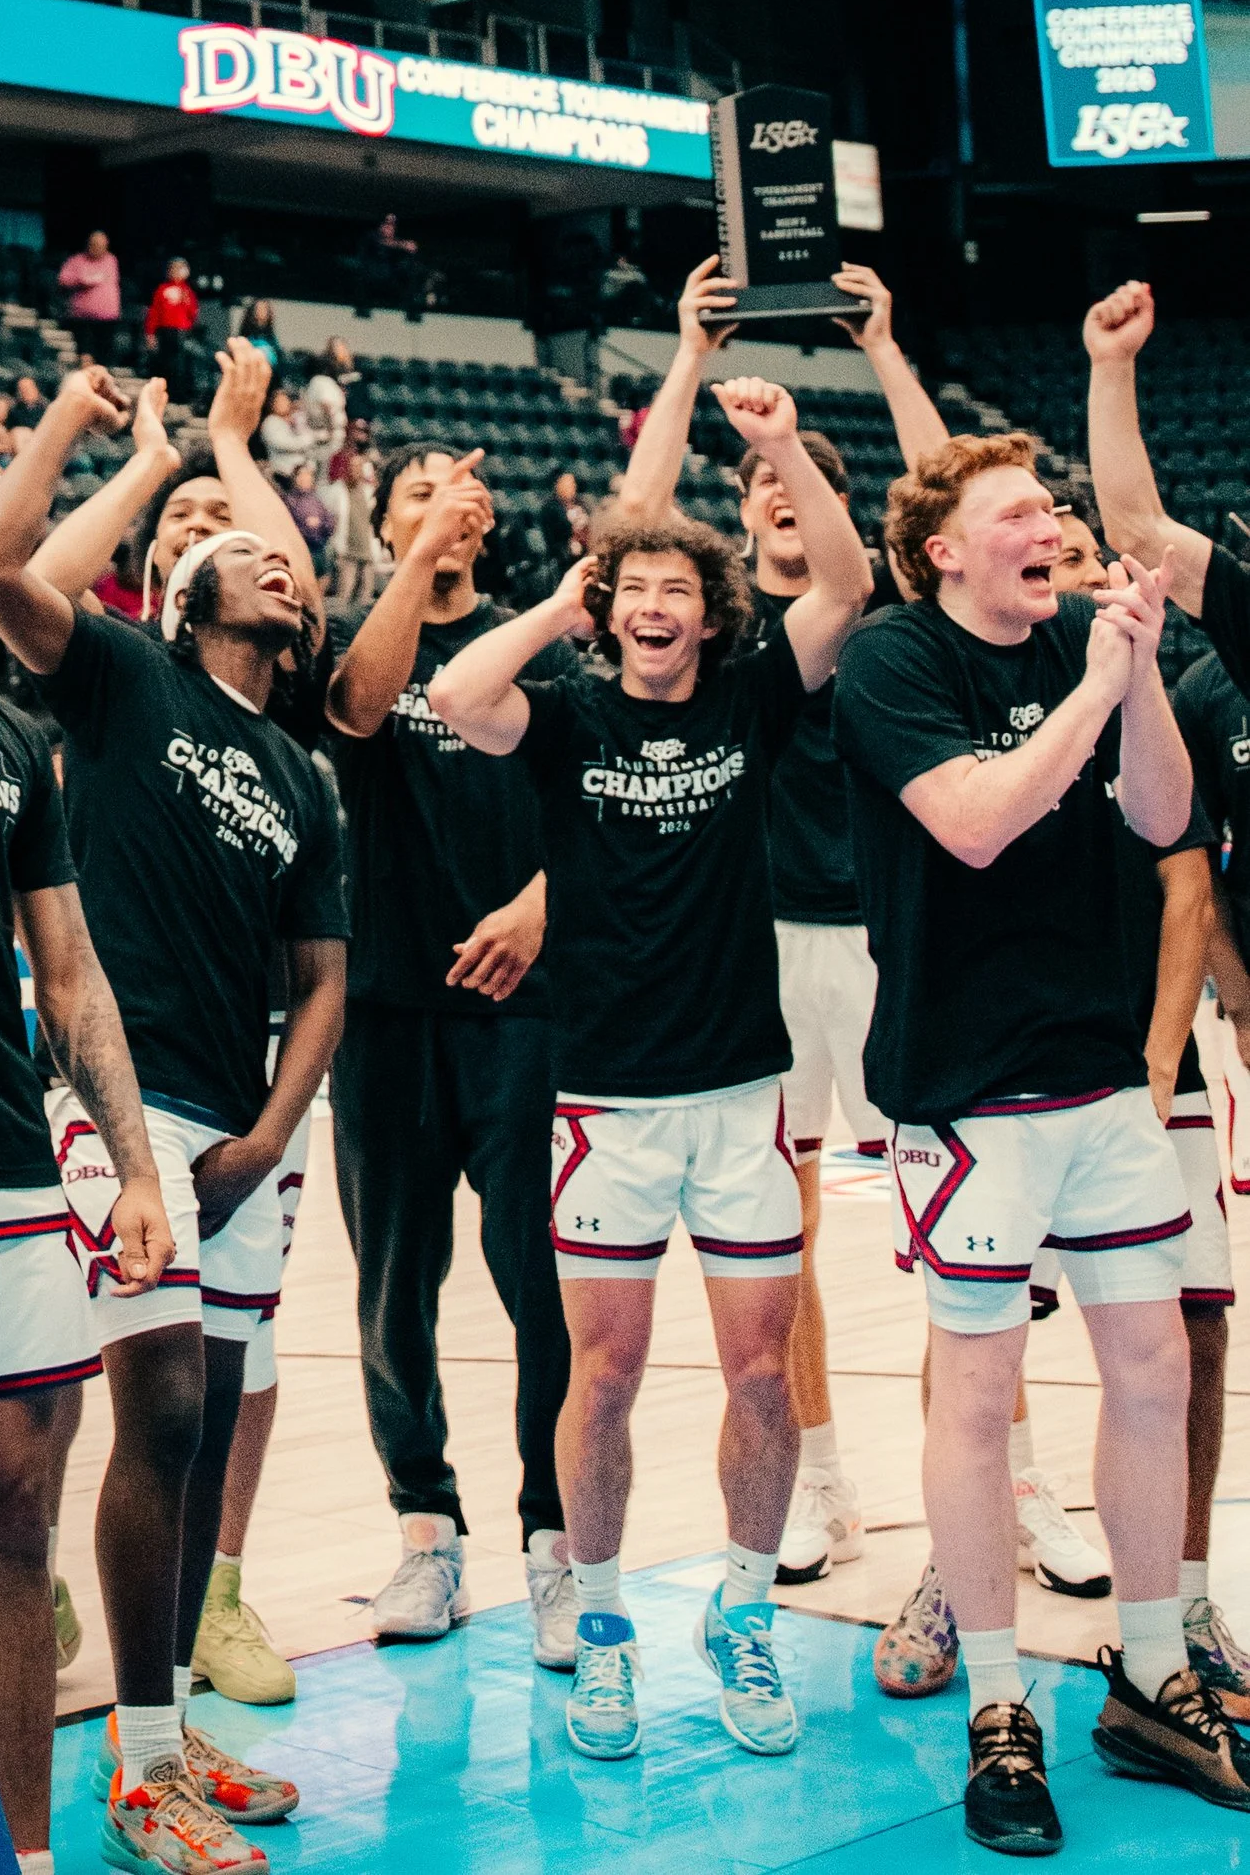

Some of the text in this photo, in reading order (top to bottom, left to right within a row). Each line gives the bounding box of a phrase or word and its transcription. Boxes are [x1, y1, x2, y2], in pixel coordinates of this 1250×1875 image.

[1046, 3, 1193, 28] CONFERENCE
[1047, 23, 1196, 50] TOURNAMENT
[1058, 43, 1189, 68] CHAMPIONS
[178, 23, 396, 137] DBU
[1094, 66, 1157, 94] 2026
[397, 57, 710, 135] CONFERENCE TOURNAMENT
[472, 103, 651, 167] CHAMPIONS
[658, 820, 692, 835] 2026
[898, 1149, 942, 1167] DBU
